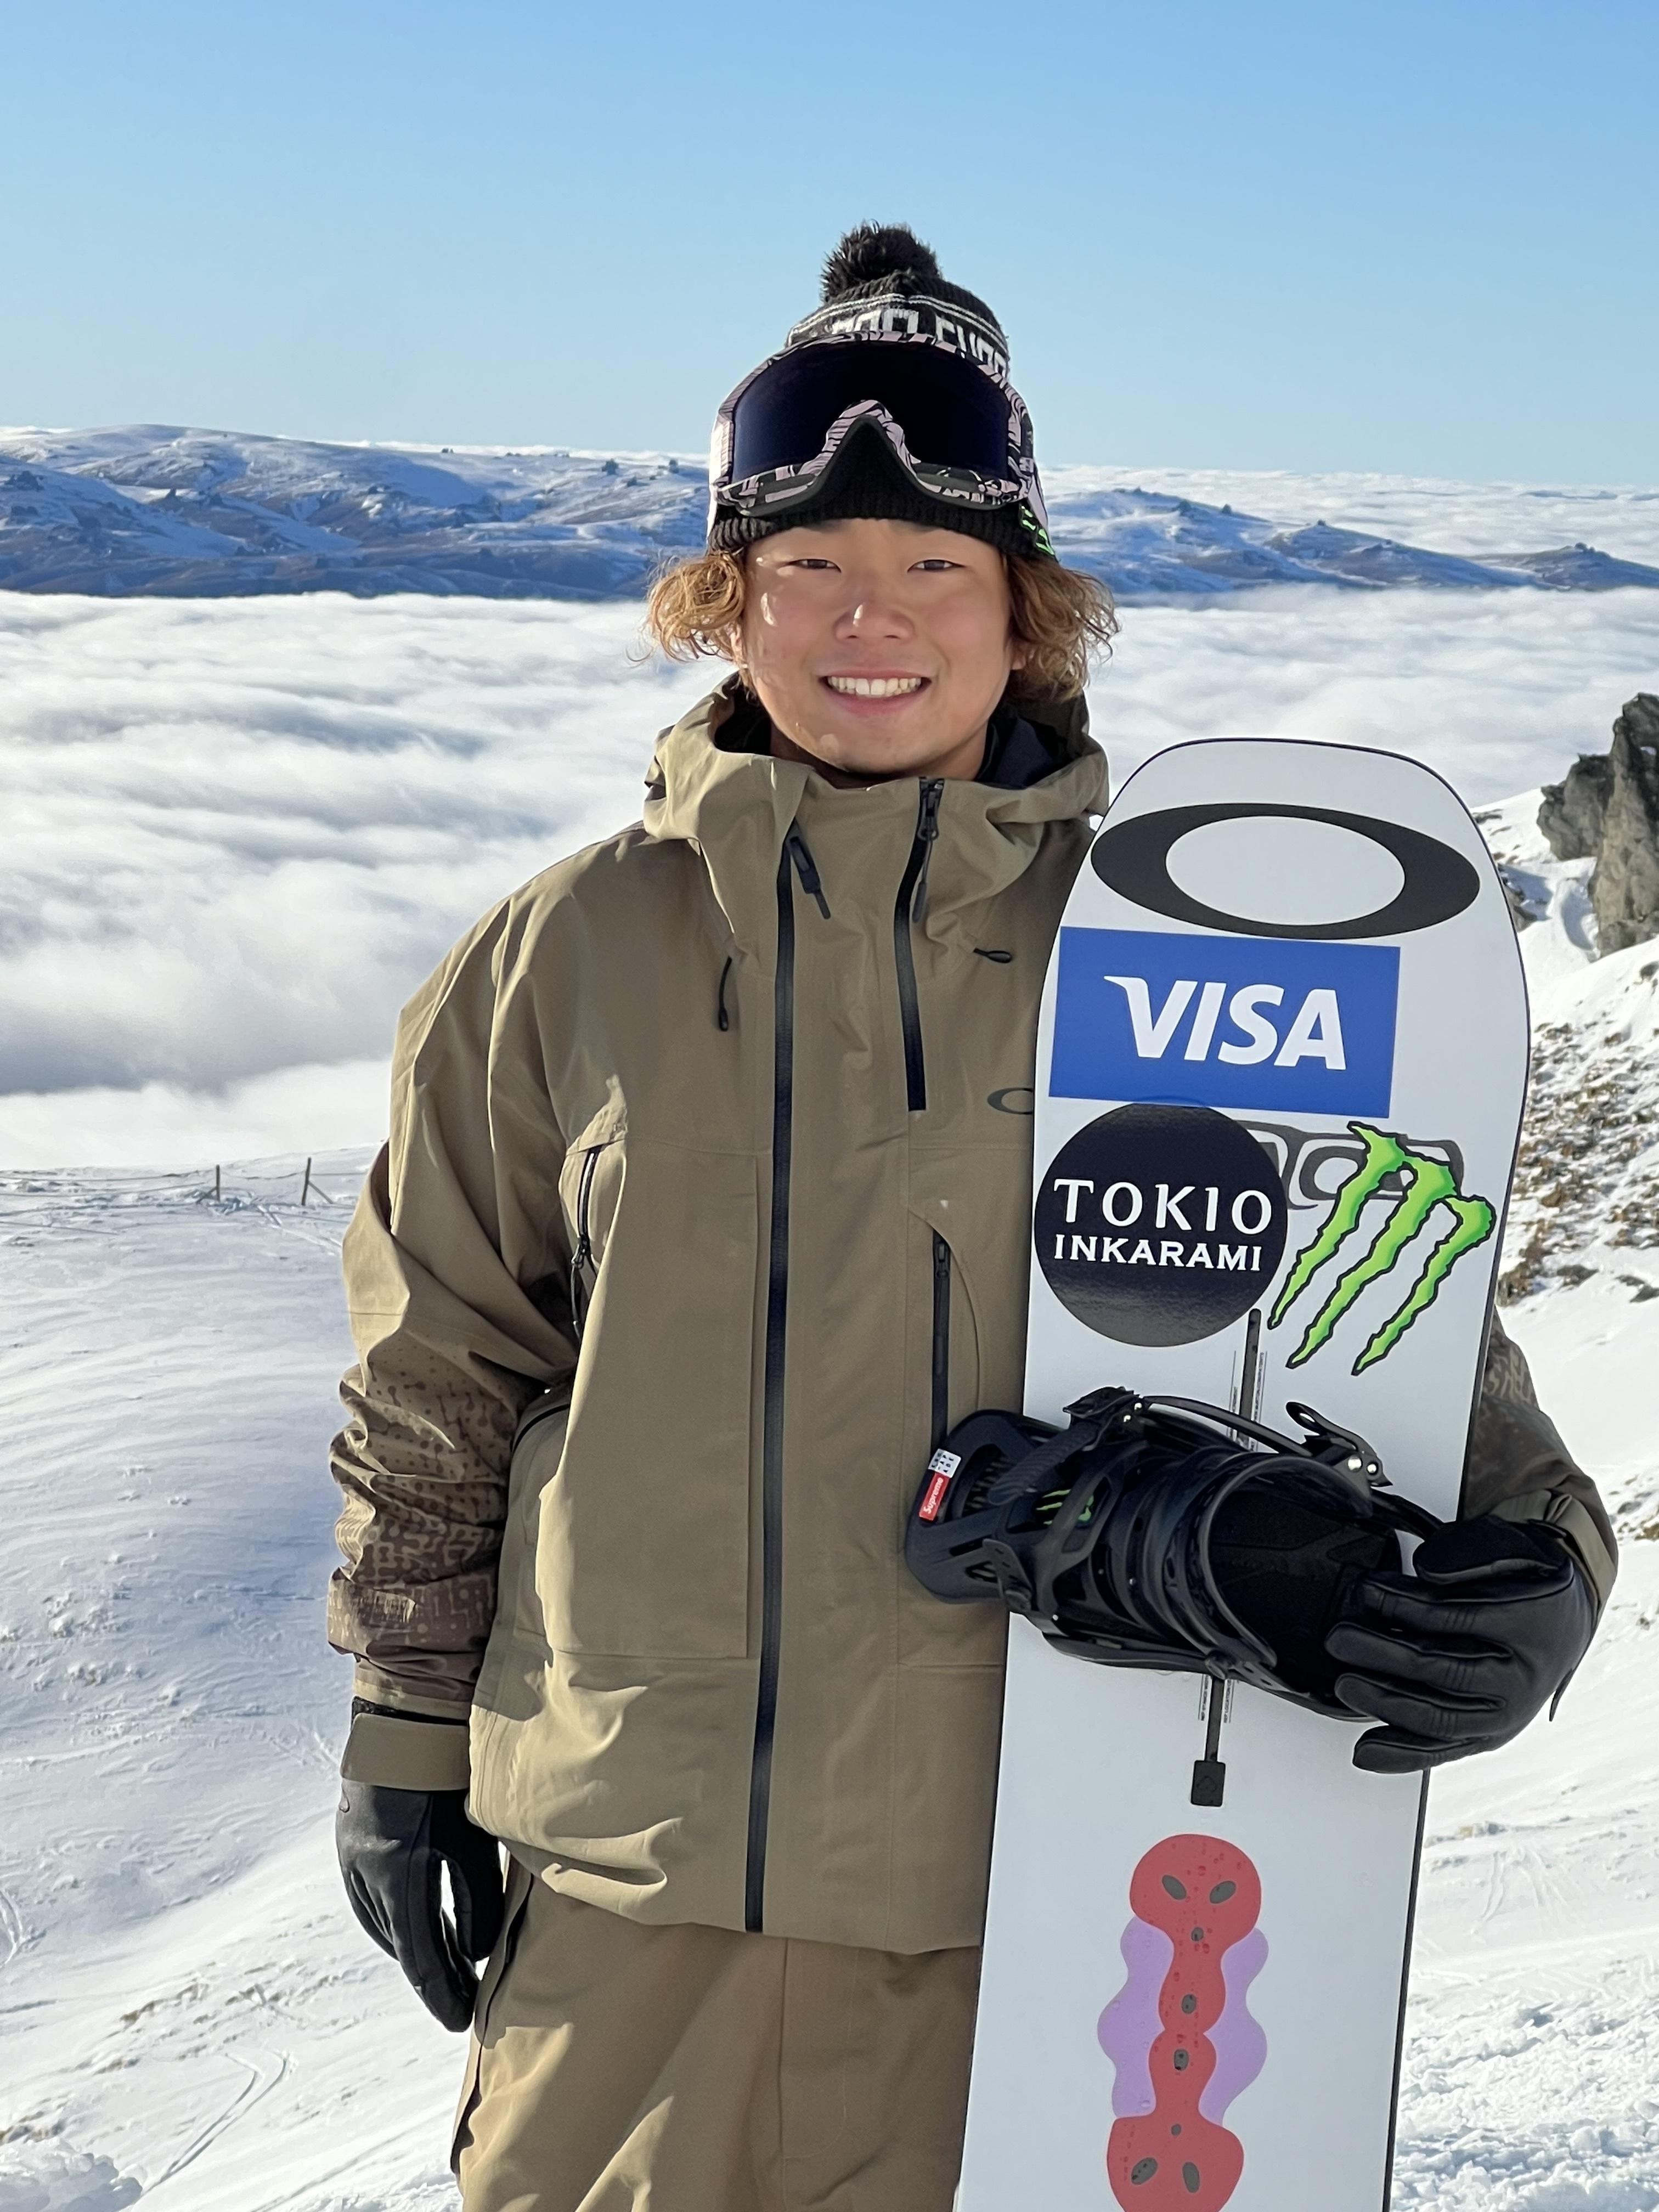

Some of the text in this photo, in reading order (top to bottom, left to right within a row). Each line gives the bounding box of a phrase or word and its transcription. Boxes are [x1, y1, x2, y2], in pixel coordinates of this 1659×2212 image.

[1104, 976, 1346, 1070] VISA
[1054, 1179, 1272, 1234] TOKIO
[1054, 1234, 1261, 1271] INKARAMI
[923, 1477, 944, 1514] Supreme
